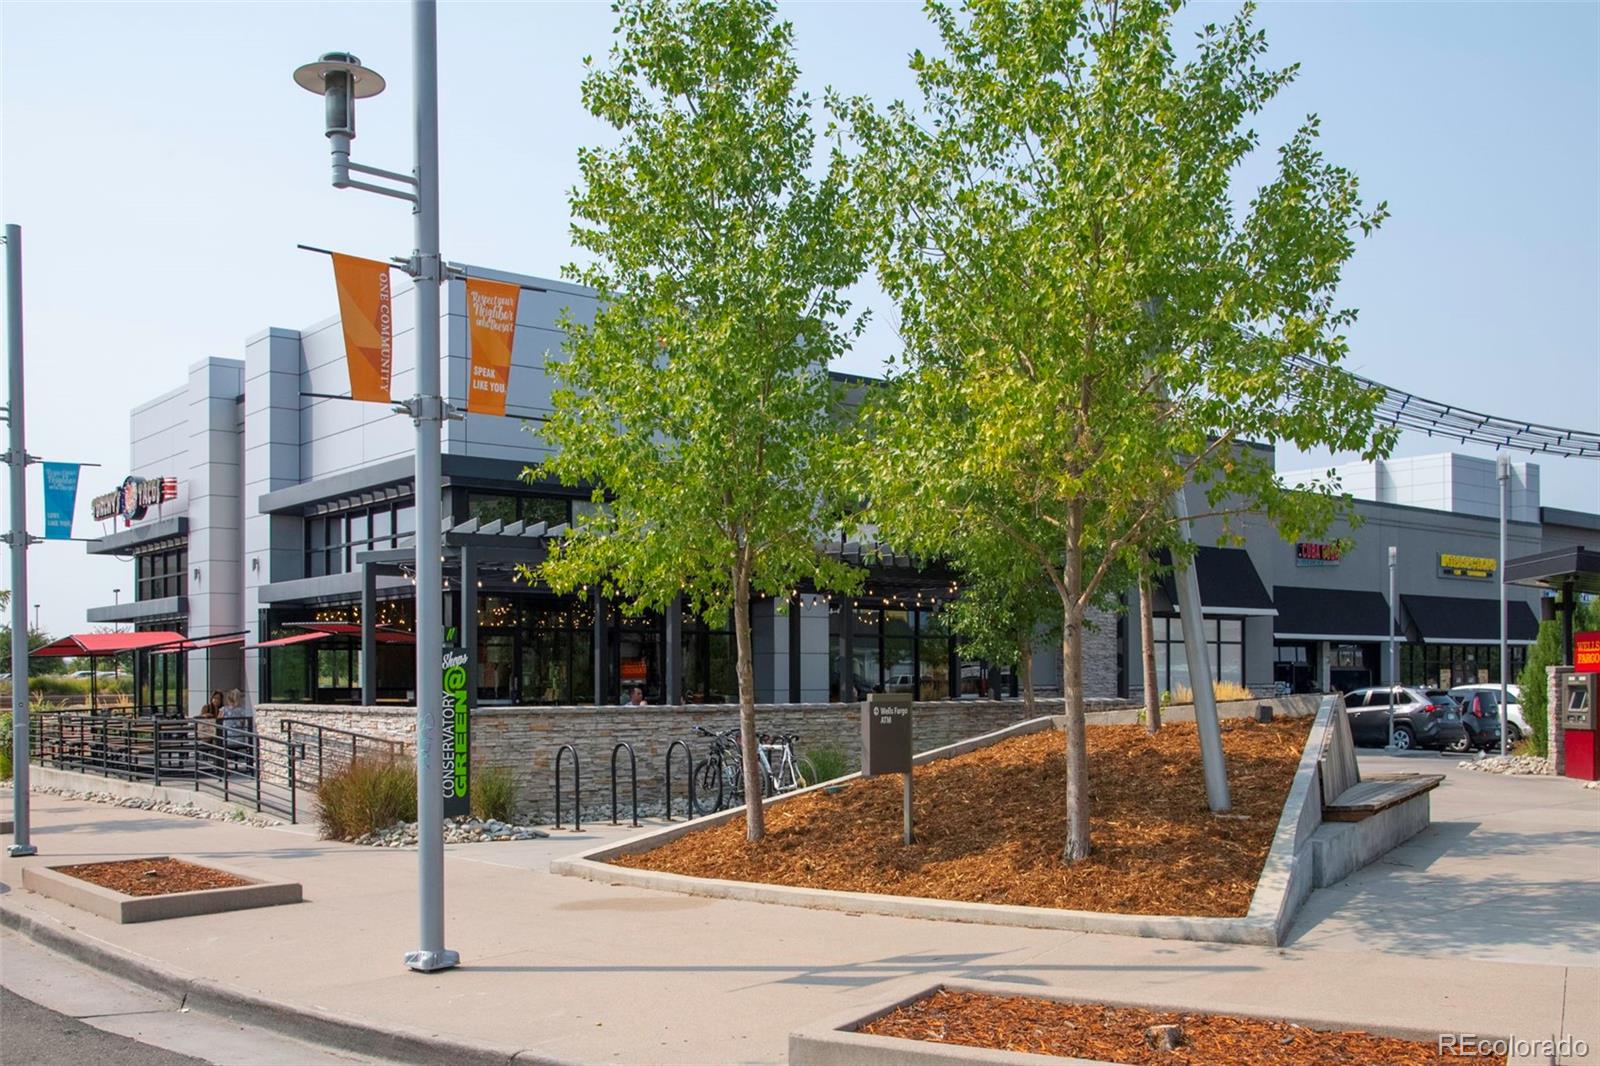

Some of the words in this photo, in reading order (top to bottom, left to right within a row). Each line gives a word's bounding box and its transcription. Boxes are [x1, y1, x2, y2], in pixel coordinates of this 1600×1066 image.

[378, 272, 389, 300] ONE
[380, 304, 391, 392] COMMUNITY
[473, 366, 496, 379] SPEAK
[473, 379, 489, 391] LIKE
[1576, 640, 1600, 652] WELLS
[442, 651, 468, 670] Shops
[1577, 652, 1600, 665] FARGO
[880, 707, 893, 715] Wells
[894, 707, 908, 716] Fargo
[880, 716, 892, 724] ATM
[442, 690, 455, 798] CONSERVATORY
